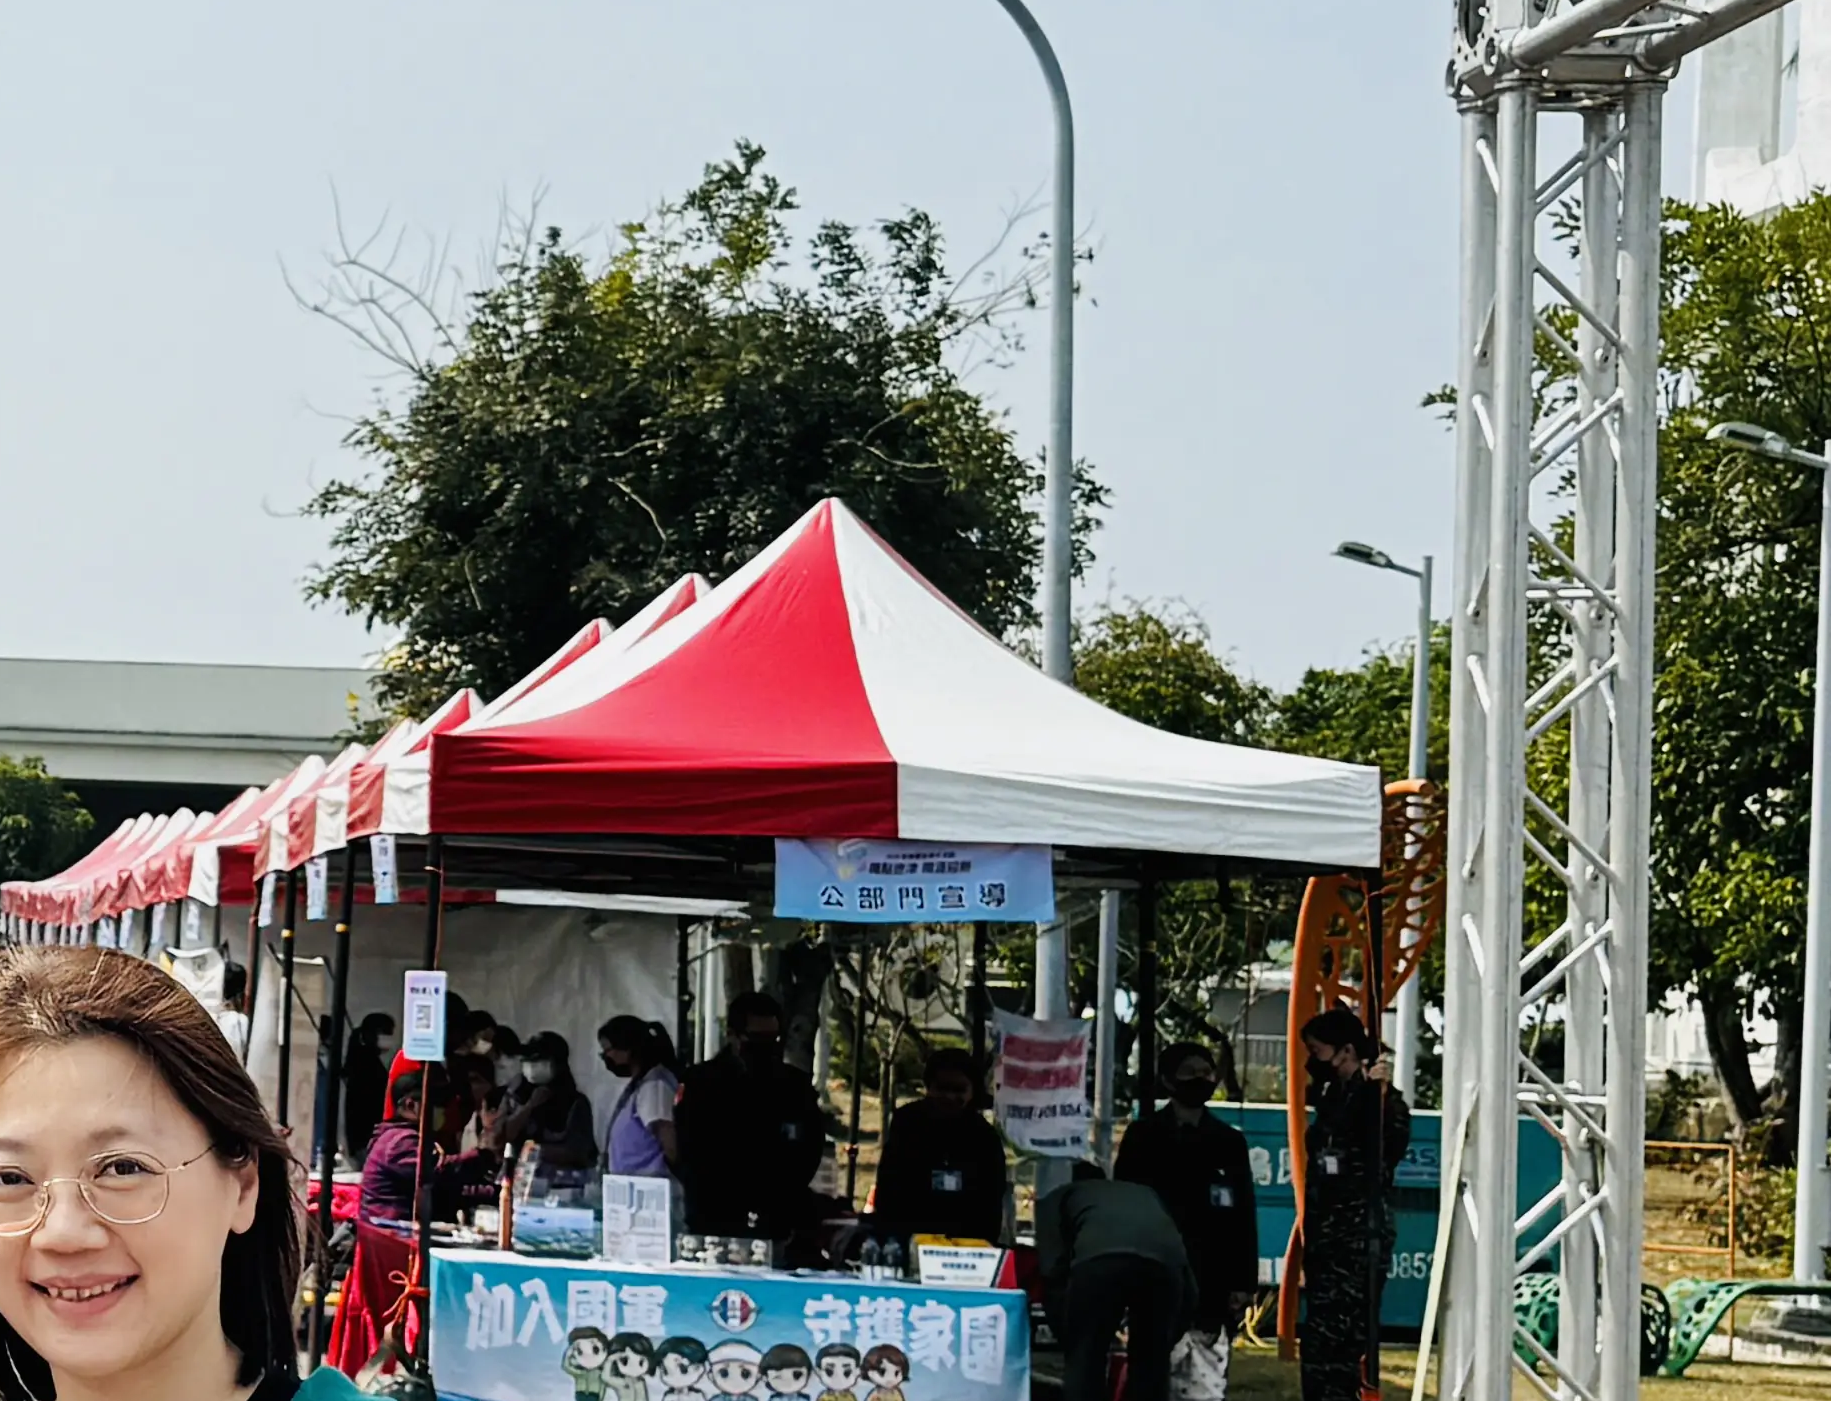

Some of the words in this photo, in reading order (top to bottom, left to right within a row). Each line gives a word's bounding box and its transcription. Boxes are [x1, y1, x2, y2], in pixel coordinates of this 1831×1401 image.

[820, 883, 1006, 910] 公部門宣導
[465, 1272, 669, 1350] 加入國軍
[803, 1294, 1007, 1385] 守護家園
